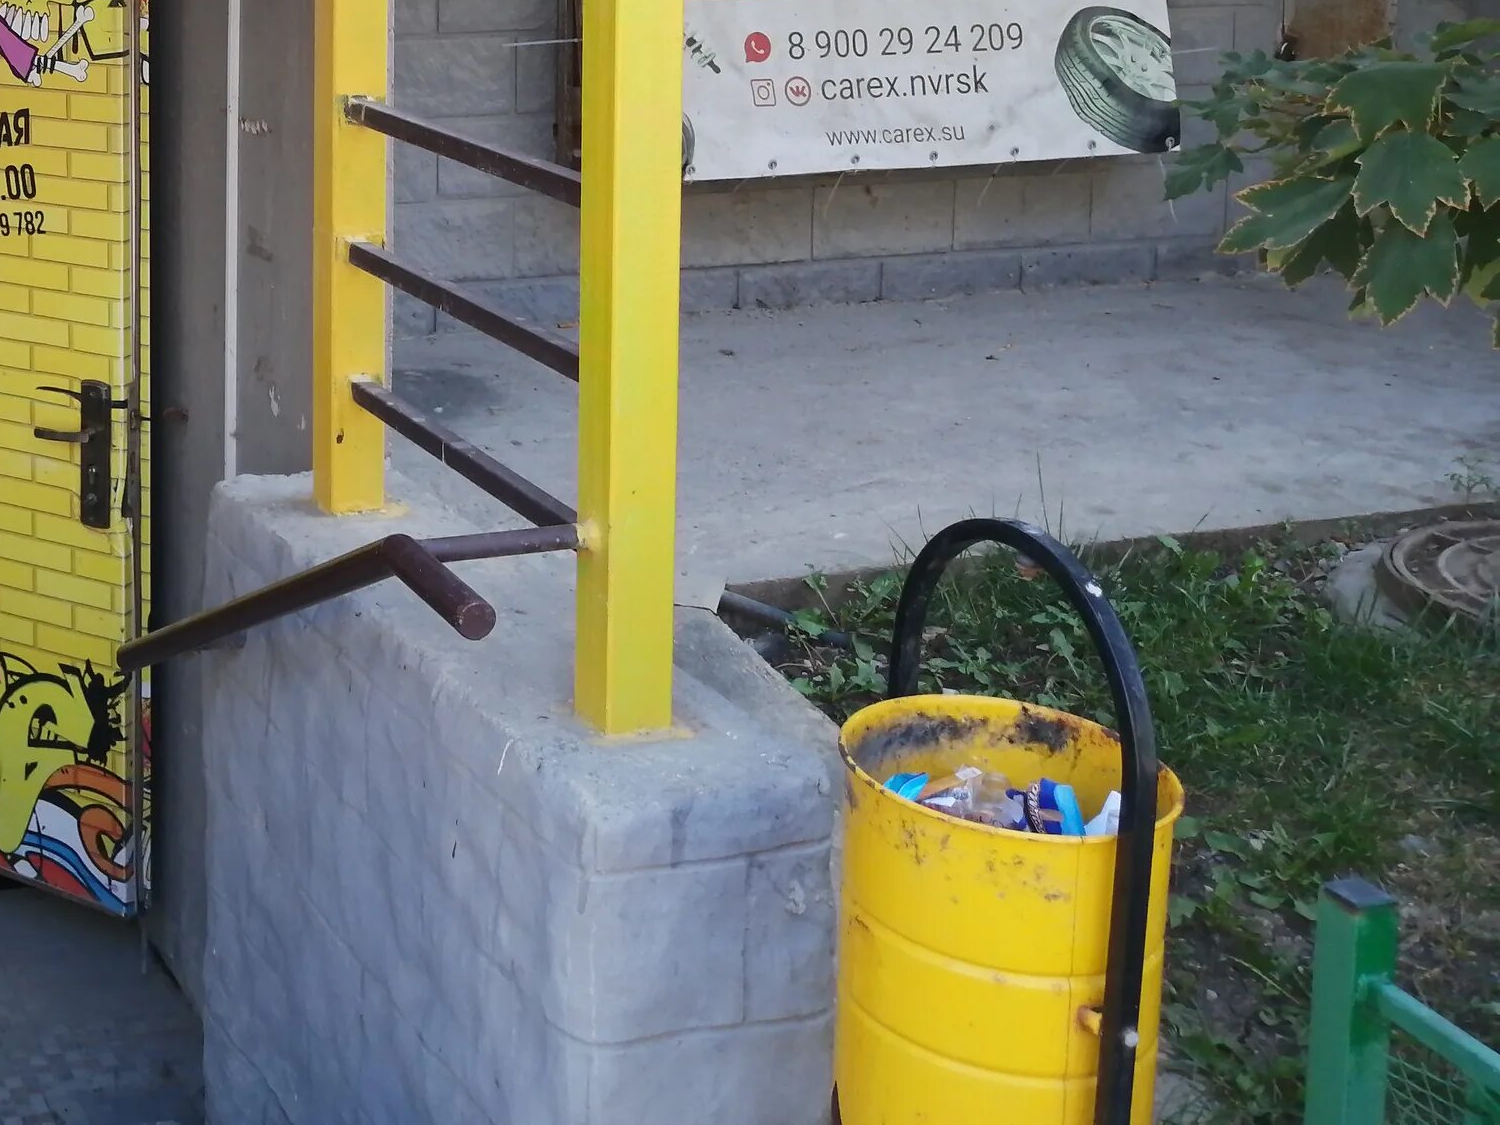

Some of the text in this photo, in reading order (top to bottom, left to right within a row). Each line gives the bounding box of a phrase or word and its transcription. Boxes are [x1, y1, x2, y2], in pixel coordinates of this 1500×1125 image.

[787, 22, 1024, 60] 8 900 29 24 209
[821, 65, 989, 101] carex.nvrsk
[825, 124, 966, 147] www.carex.su
[13, 210, 46, 236] 782
